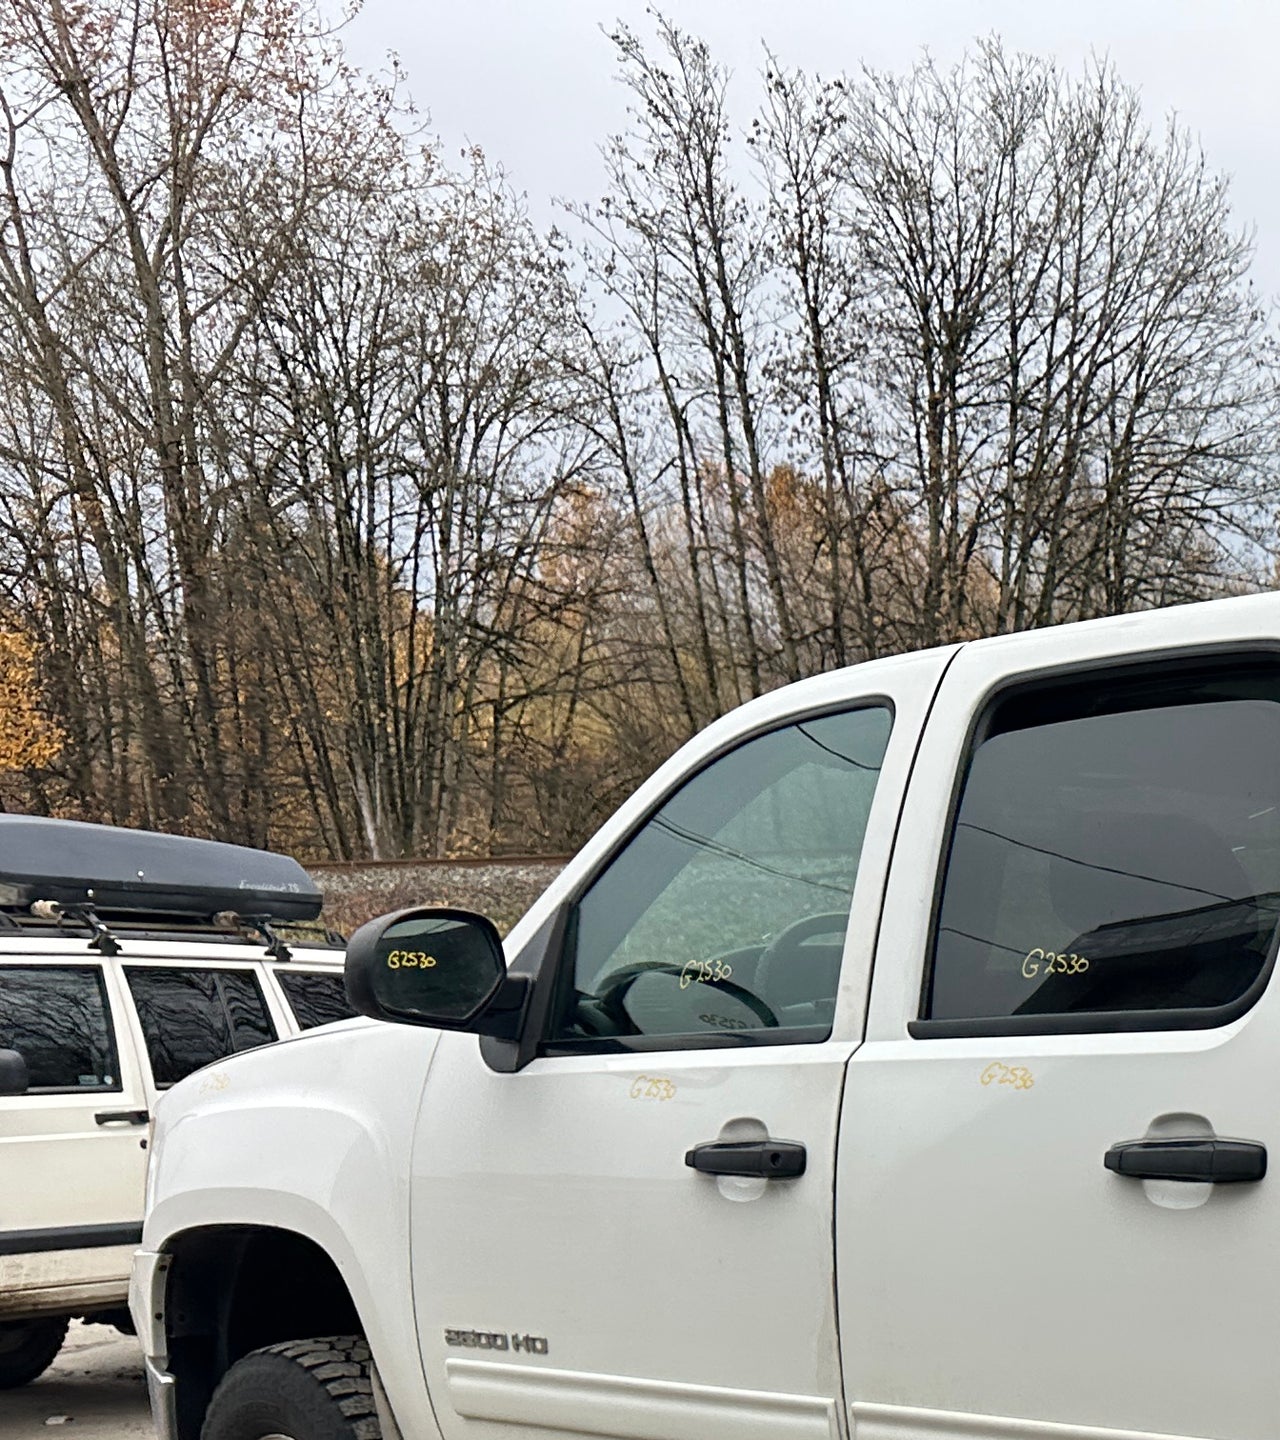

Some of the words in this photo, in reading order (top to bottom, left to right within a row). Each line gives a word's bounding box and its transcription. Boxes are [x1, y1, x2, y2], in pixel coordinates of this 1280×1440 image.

[388, 950, 437, 969] G2530
[1022, 948, 1089, 978] G2530
[680, 960, 732, 989] G2530
[980, 1061, 1035, 1090] G2530
[511, 1332, 549, 1355] HD
